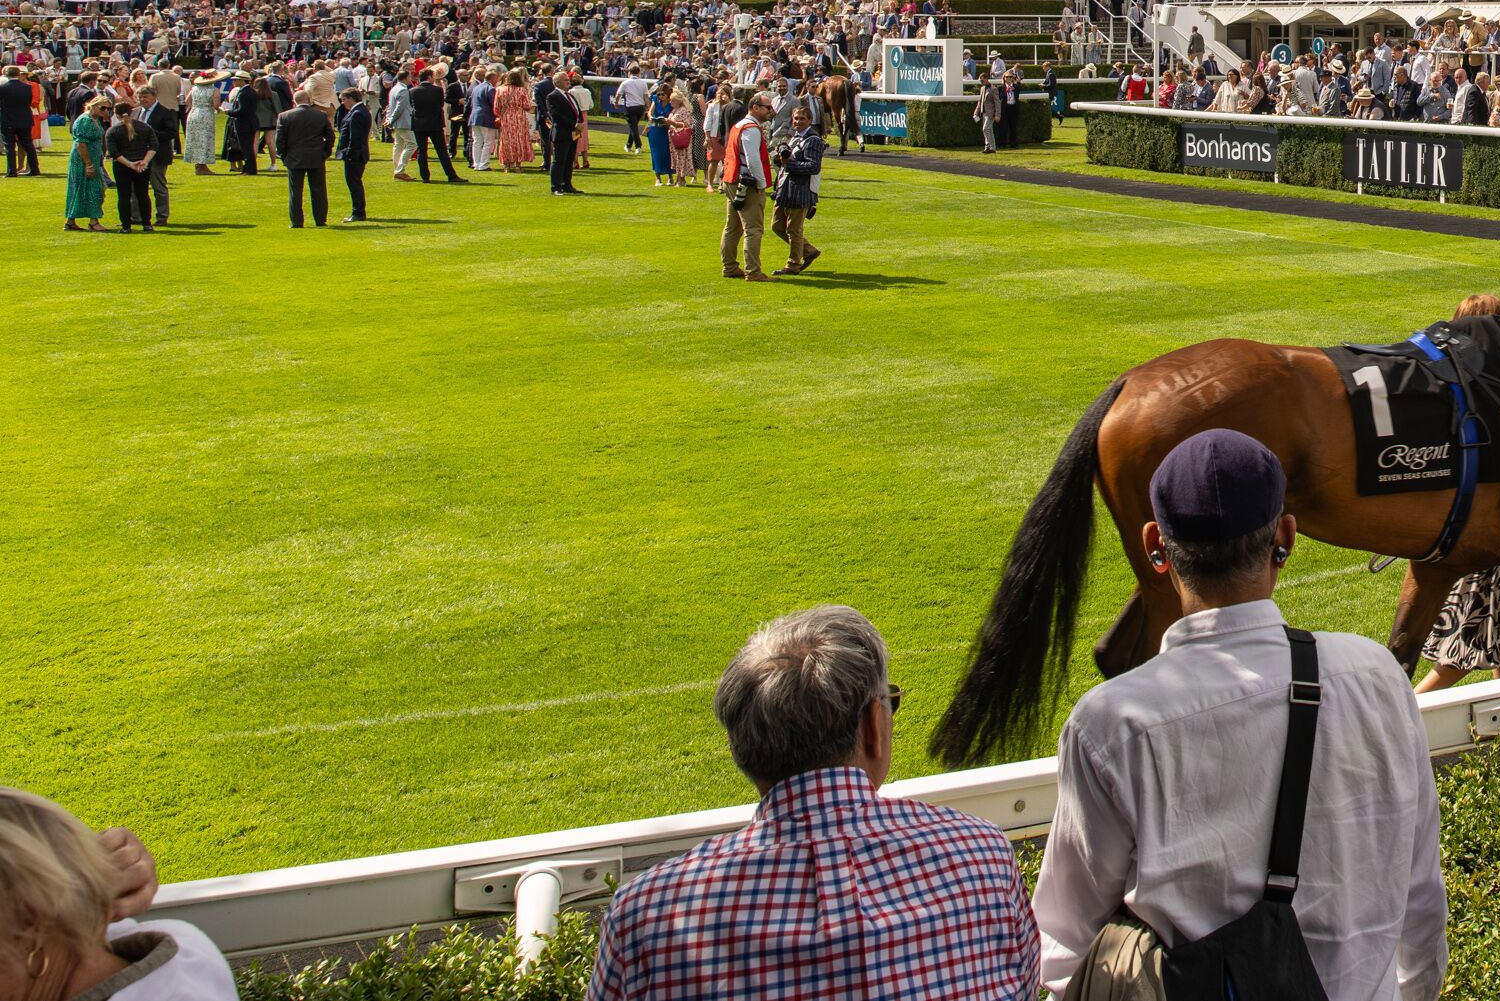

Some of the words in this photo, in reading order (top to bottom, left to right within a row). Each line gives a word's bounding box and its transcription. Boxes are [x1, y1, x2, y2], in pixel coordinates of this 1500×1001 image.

[1316, 42, 1320, 50] 1
[893, 52, 898, 63] 4
[1279, 50, 1287, 62] 3
[860, 111, 907, 130] visitQATAR
[1185, 132, 1272, 163] Bonhams
[1356, 138, 1447, 187] TATLER
[1351, 365, 1394, 437] 1
[1378, 442, 1451, 470] Regent
[1378, 473, 1402, 482] SEVEN
[1403, 471, 1421, 480] SEAS
